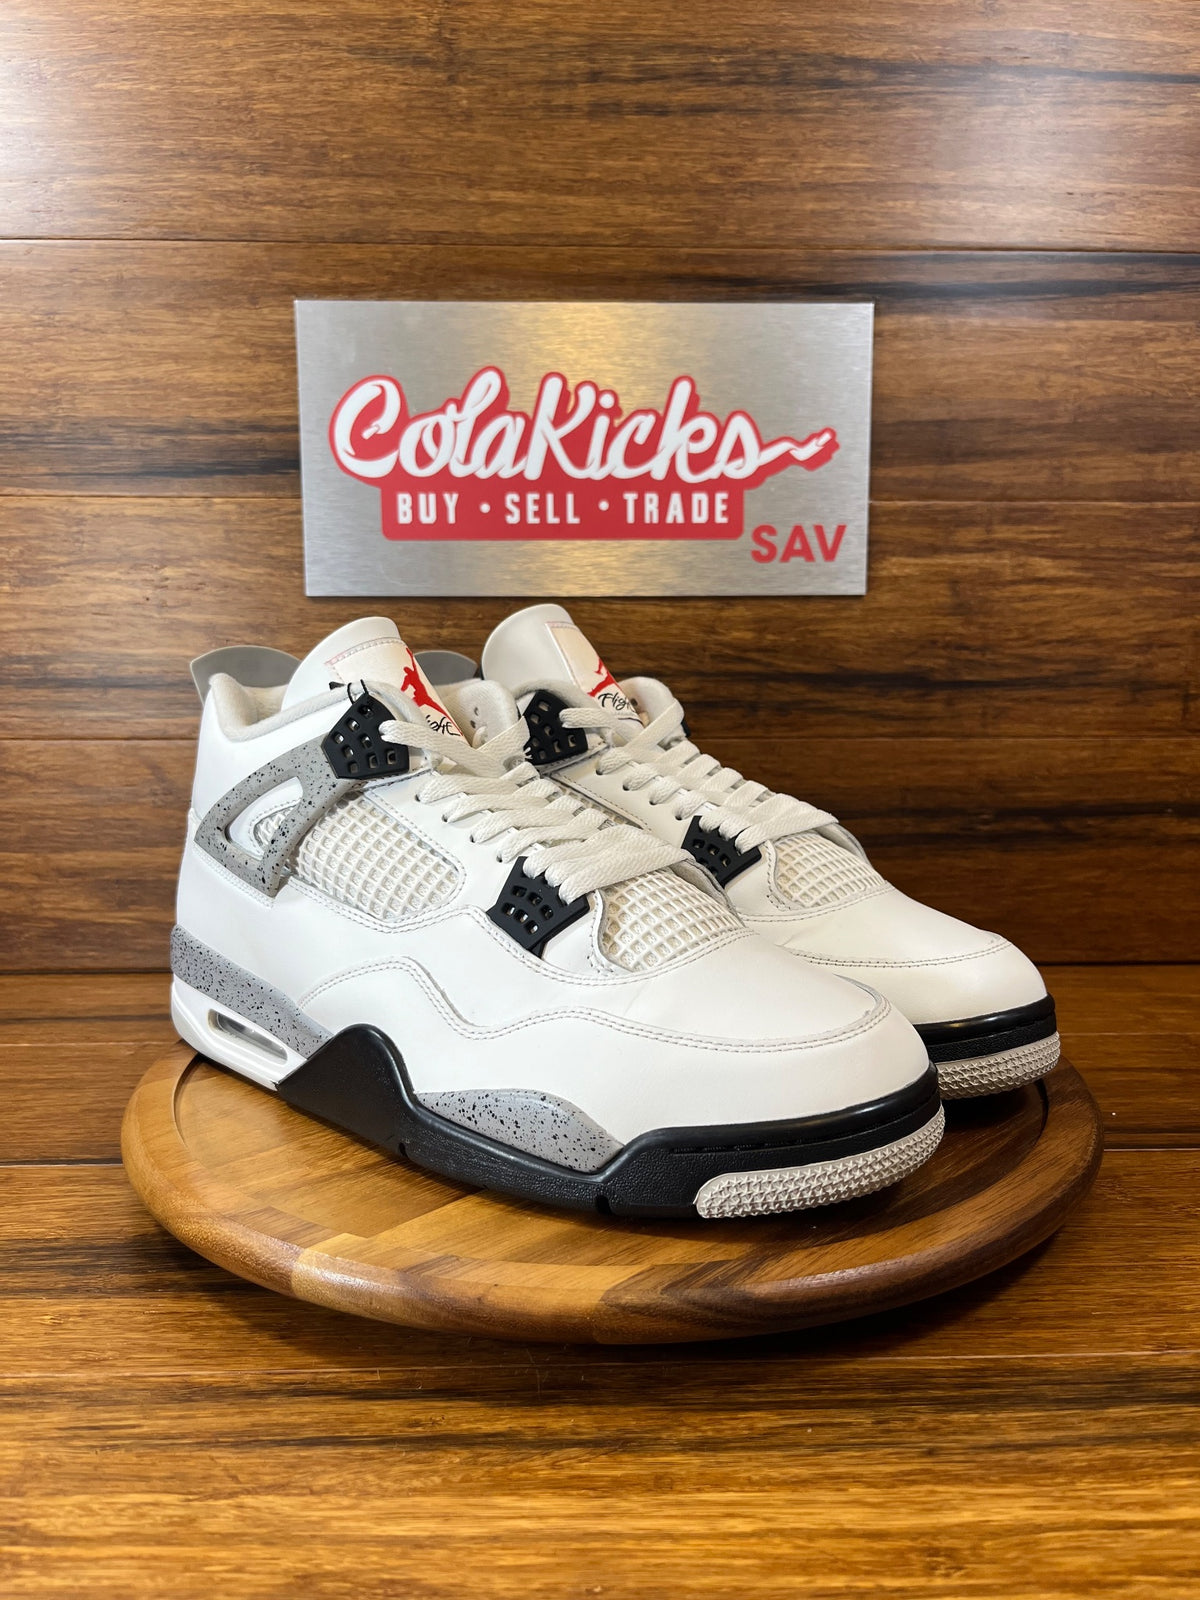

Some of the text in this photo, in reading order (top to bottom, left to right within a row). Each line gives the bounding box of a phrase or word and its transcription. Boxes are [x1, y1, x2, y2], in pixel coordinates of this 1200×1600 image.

[333, 369, 832, 484] ColaKicks
[396, 492, 729, 525] BUY SELL TRADE
[751, 524, 847, 564] SAV
